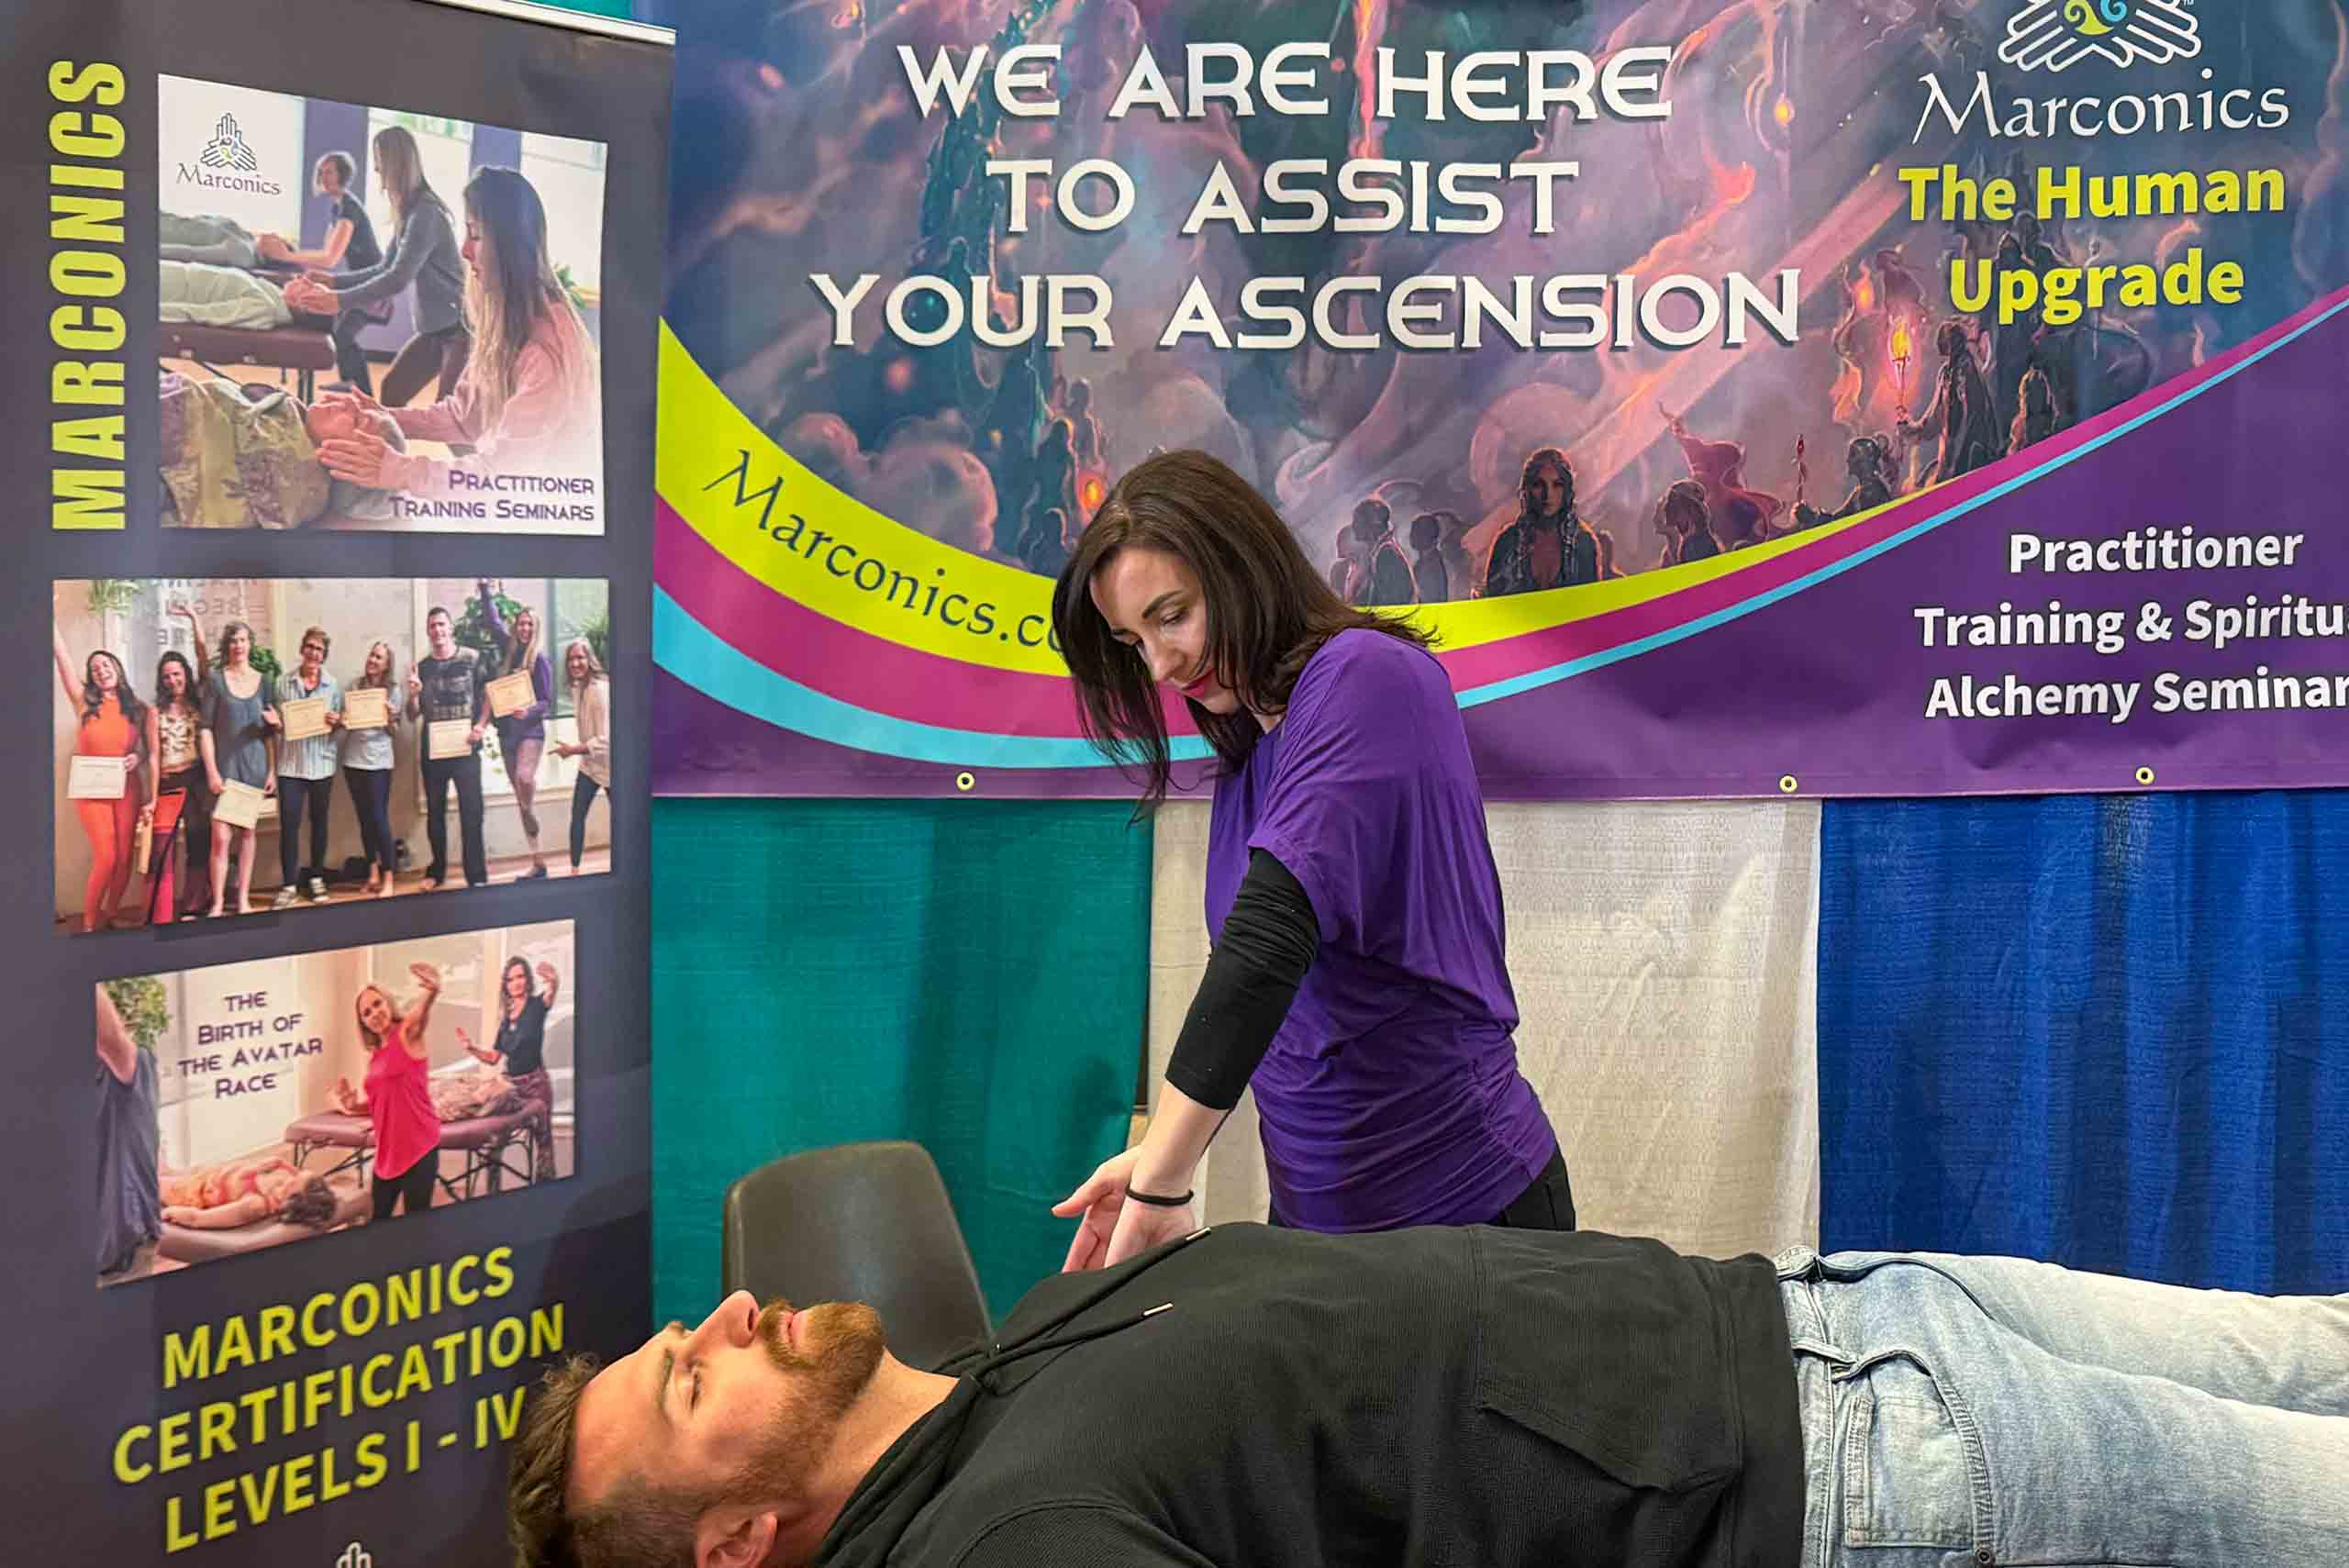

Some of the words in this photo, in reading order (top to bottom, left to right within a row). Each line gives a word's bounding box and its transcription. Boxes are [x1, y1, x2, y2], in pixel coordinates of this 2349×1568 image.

[896, 42, 1062, 119] WE
[1108, 42, 1330, 119] ARE
[1376, 46, 1674, 122] HERE
[1912, 67, 2289, 144] Marconics
[176, 161, 281, 195] Marconics
[985, 159, 1136, 235] TO
[1181, 159, 1579, 235] ASSIST
[1898, 164, 2015, 221] The
[2037, 165, 2285, 221] Human
[49, 60, 126, 530] MARCONICS
[809, 273, 1115, 349] YOUR
[1158, 269, 1801, 350] ASCENSION
[1950, 247, 2244, 325] Upgrade
[449, 469, 595, 495] PRACTITIONER
[2009, 525, 2304, 573] Practitioner
[1914, 601, 2125, 654] Training
[2135, 602, 2172, 641] &
[2184, 594, 2349, 649] Spiritu
[1924, 674, 2141, 723] Alchemy
[224, 991, 267, 1013] THE
[273, 1013, 304, 1032] OF
[178, 1054, 222, 1078] THE
[231, 1038, 322, 1067] AVATAR
[161, 1246, 514, 1389] MARCONICS
[113, 1302, 565, 1485] CERTIFICATION
[165, 1432, 388, 1554] LEVELS
[405, 1420, 420, 1473] I
[438, 1431, 458, 1447] -
[474, 1385, 526, 1450] IV
